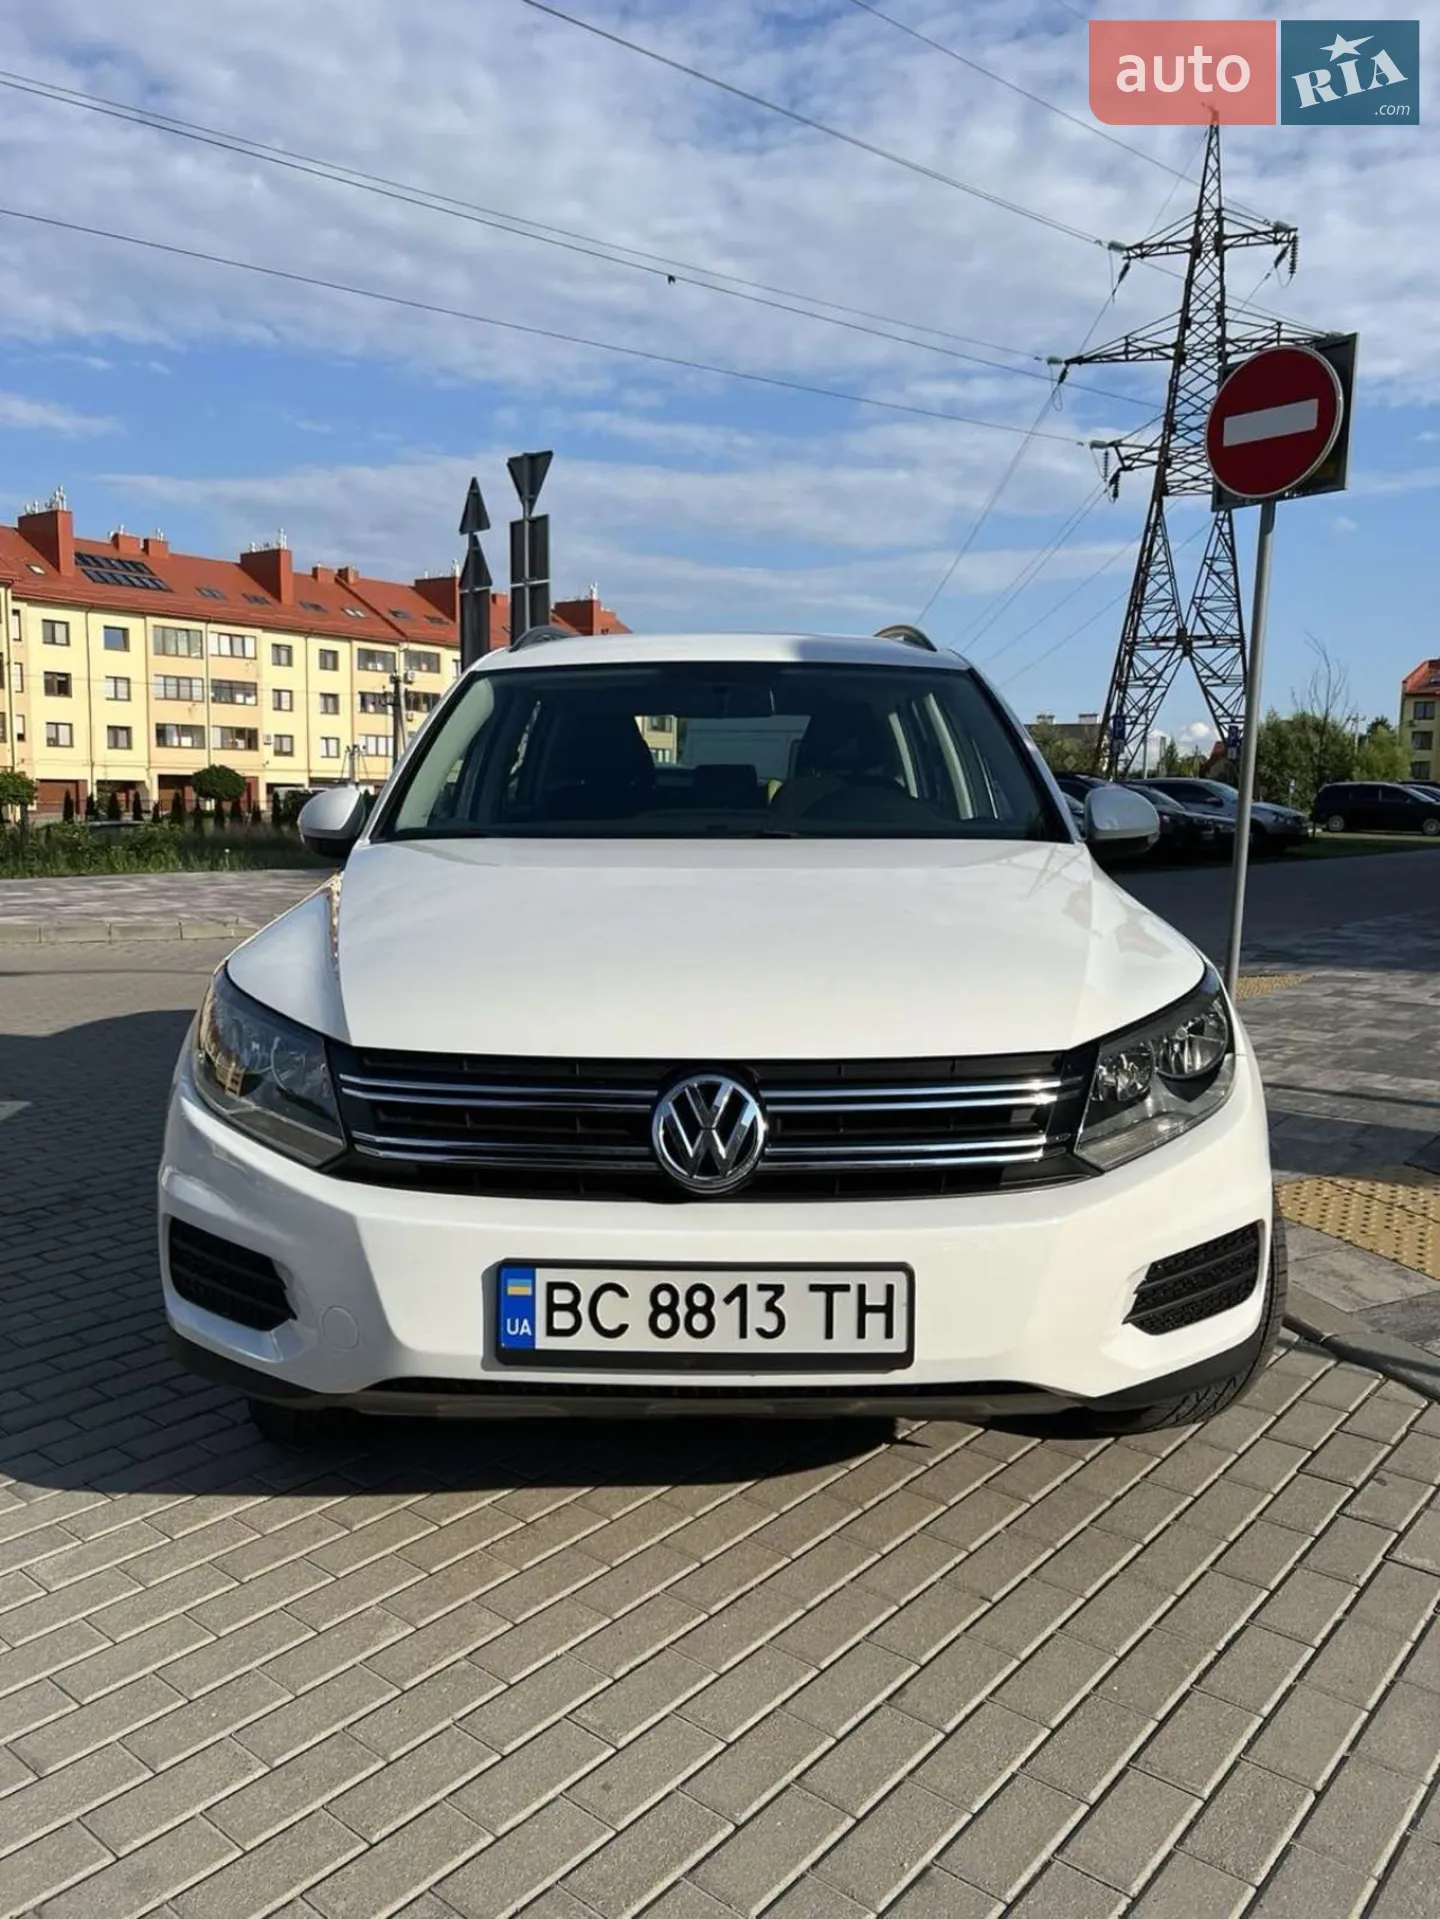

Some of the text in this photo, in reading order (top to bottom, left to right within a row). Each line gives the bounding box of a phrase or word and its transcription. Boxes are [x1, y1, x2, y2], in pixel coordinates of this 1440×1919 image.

[506, 1317, 533, 1336] UA
[546, 1281, 894, 1340] BC 8813 TH
